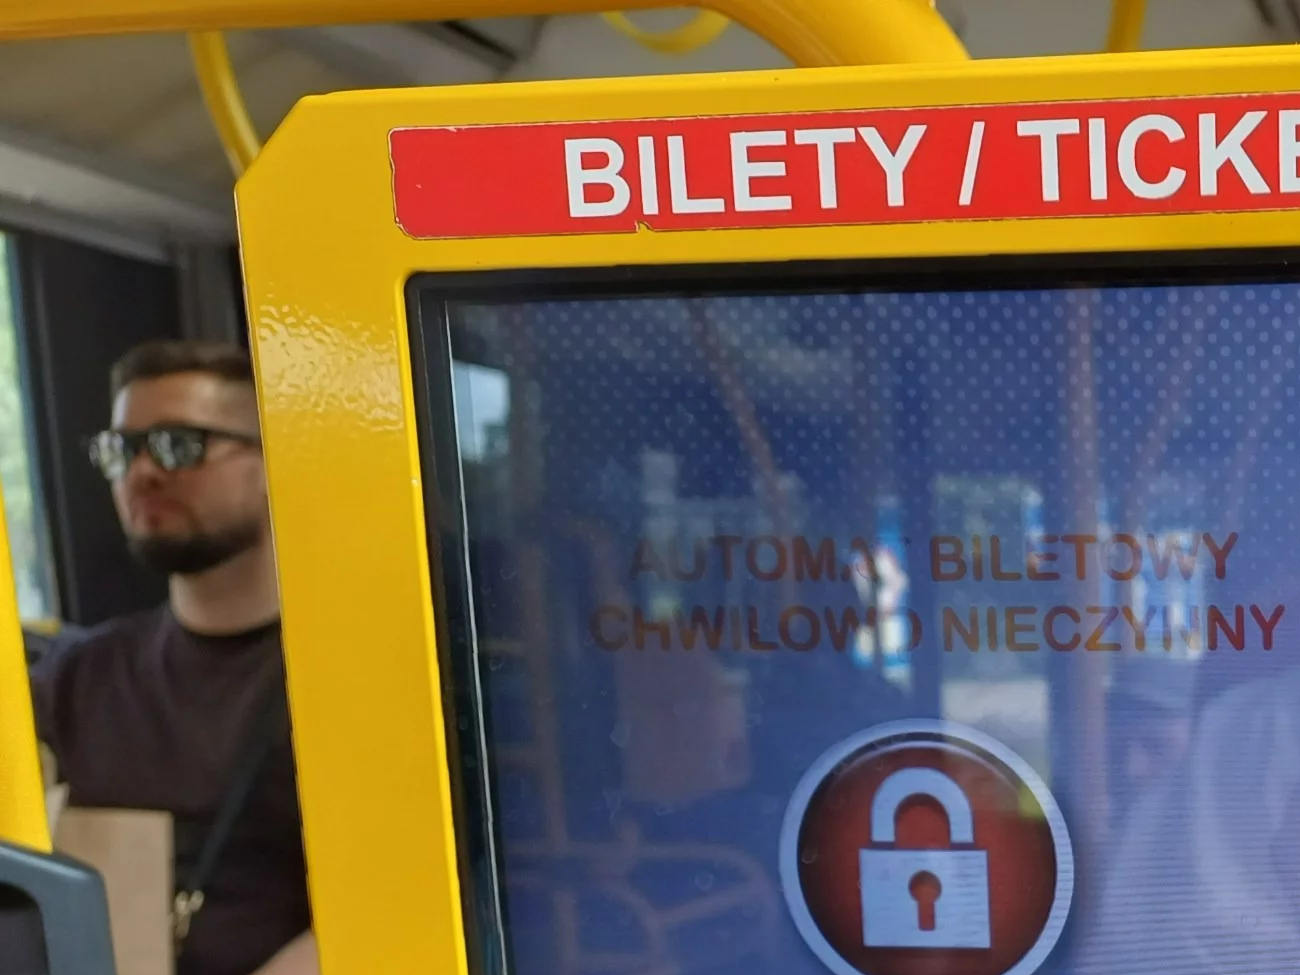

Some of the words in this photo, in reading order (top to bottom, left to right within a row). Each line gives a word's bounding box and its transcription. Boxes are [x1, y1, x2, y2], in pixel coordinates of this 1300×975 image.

[563, 123, 928, 218] BILETY
[957, 120, 985, 207] /
[930, 531, 1239, 582] BILETOWY
[942, 603, 1286, 652] NIECZYNNY
